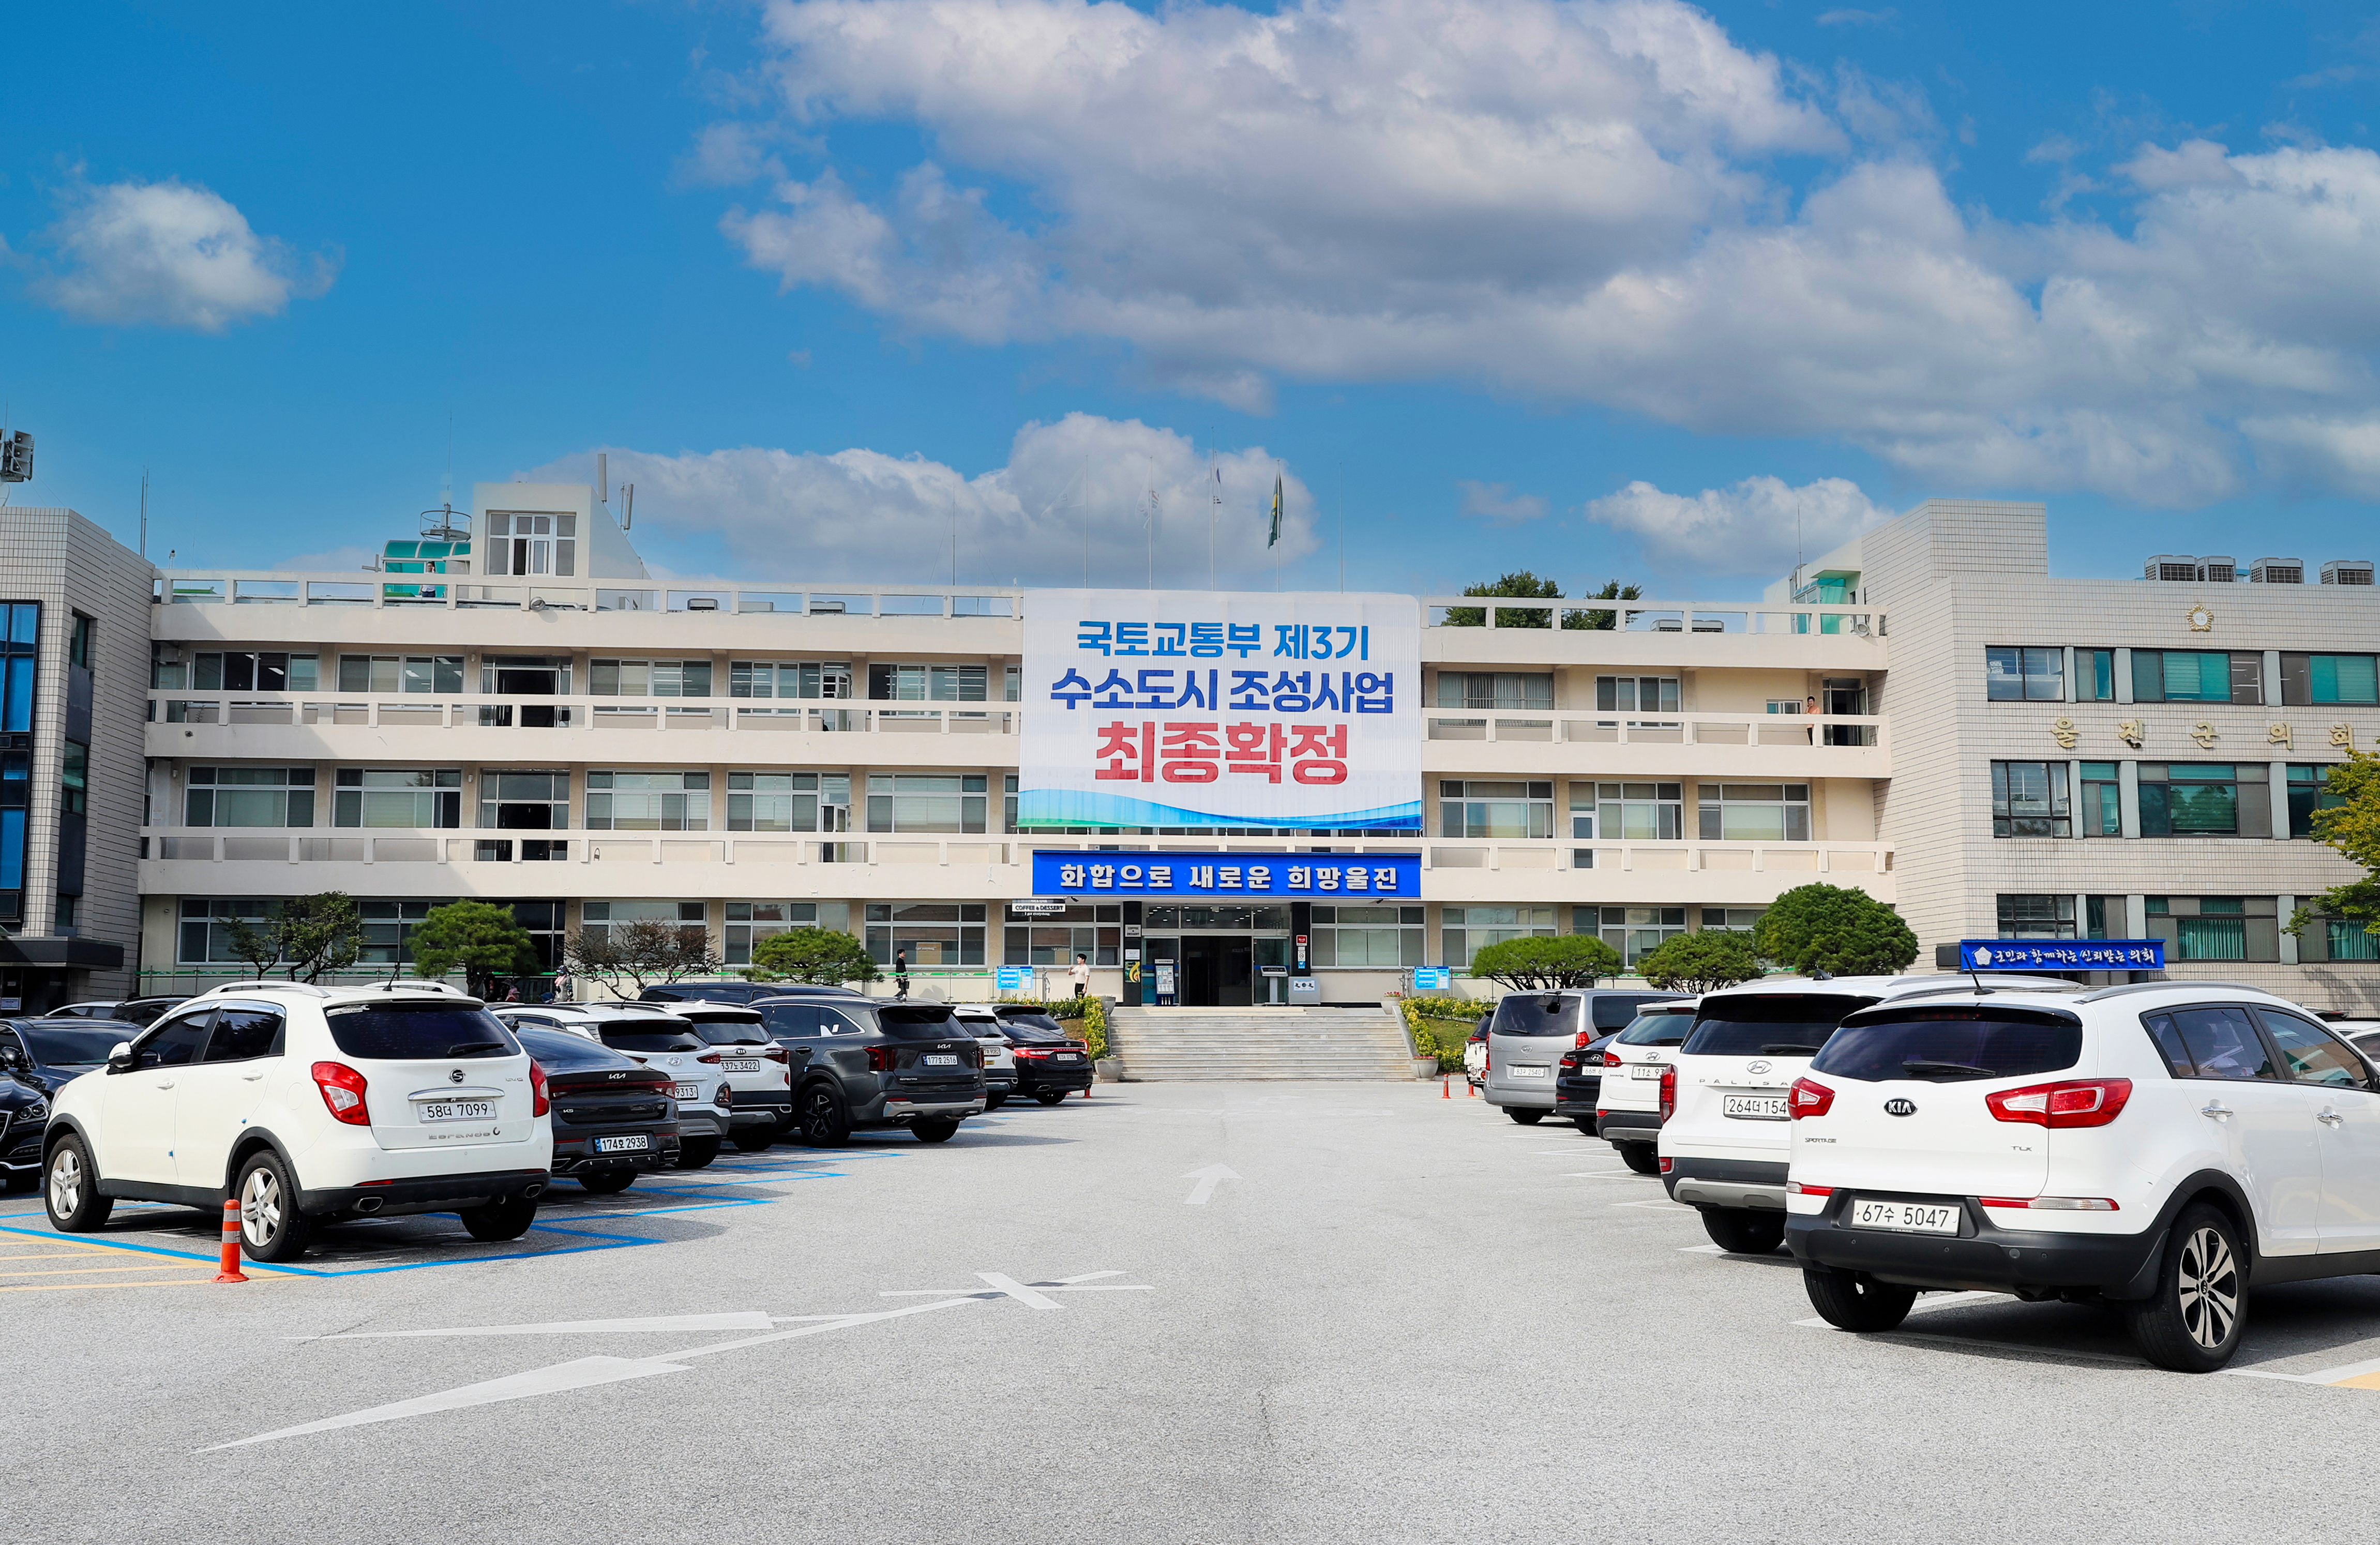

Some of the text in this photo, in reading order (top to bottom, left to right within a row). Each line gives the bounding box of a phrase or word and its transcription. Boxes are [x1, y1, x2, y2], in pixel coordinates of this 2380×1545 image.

[1078, 621, 1368, 660] 국토교통부 제3기
[1051, 668, 1393, 714] 수소도시 조성사업
[2051, 717, 2354, 750] 울진군의회
[1095, 722, 1347, 785] 최종확정
[1060, 864, 1396, 890] 화합으로 새로운 희망울진
[1995, 947, 2156, 964] 군민과 함께하는 신뢰받는 의회
[740, 1062, 757, 1070] 3422
[943, 1056, 957, 1064] 2516
[1637, 1068, 1651, 1077] 11소
[675, 1087, 694, 1097] 9313
[427, 1103, 488, 1118] 58더 7099
[1729, 1099, 1760, 1113] 264더
[1888, 1101, 1912, 1113] KIA
[602, 1137, 646, 1150] 174호 2938
[1862, 1205, 1949, 1227] 67수 5047
